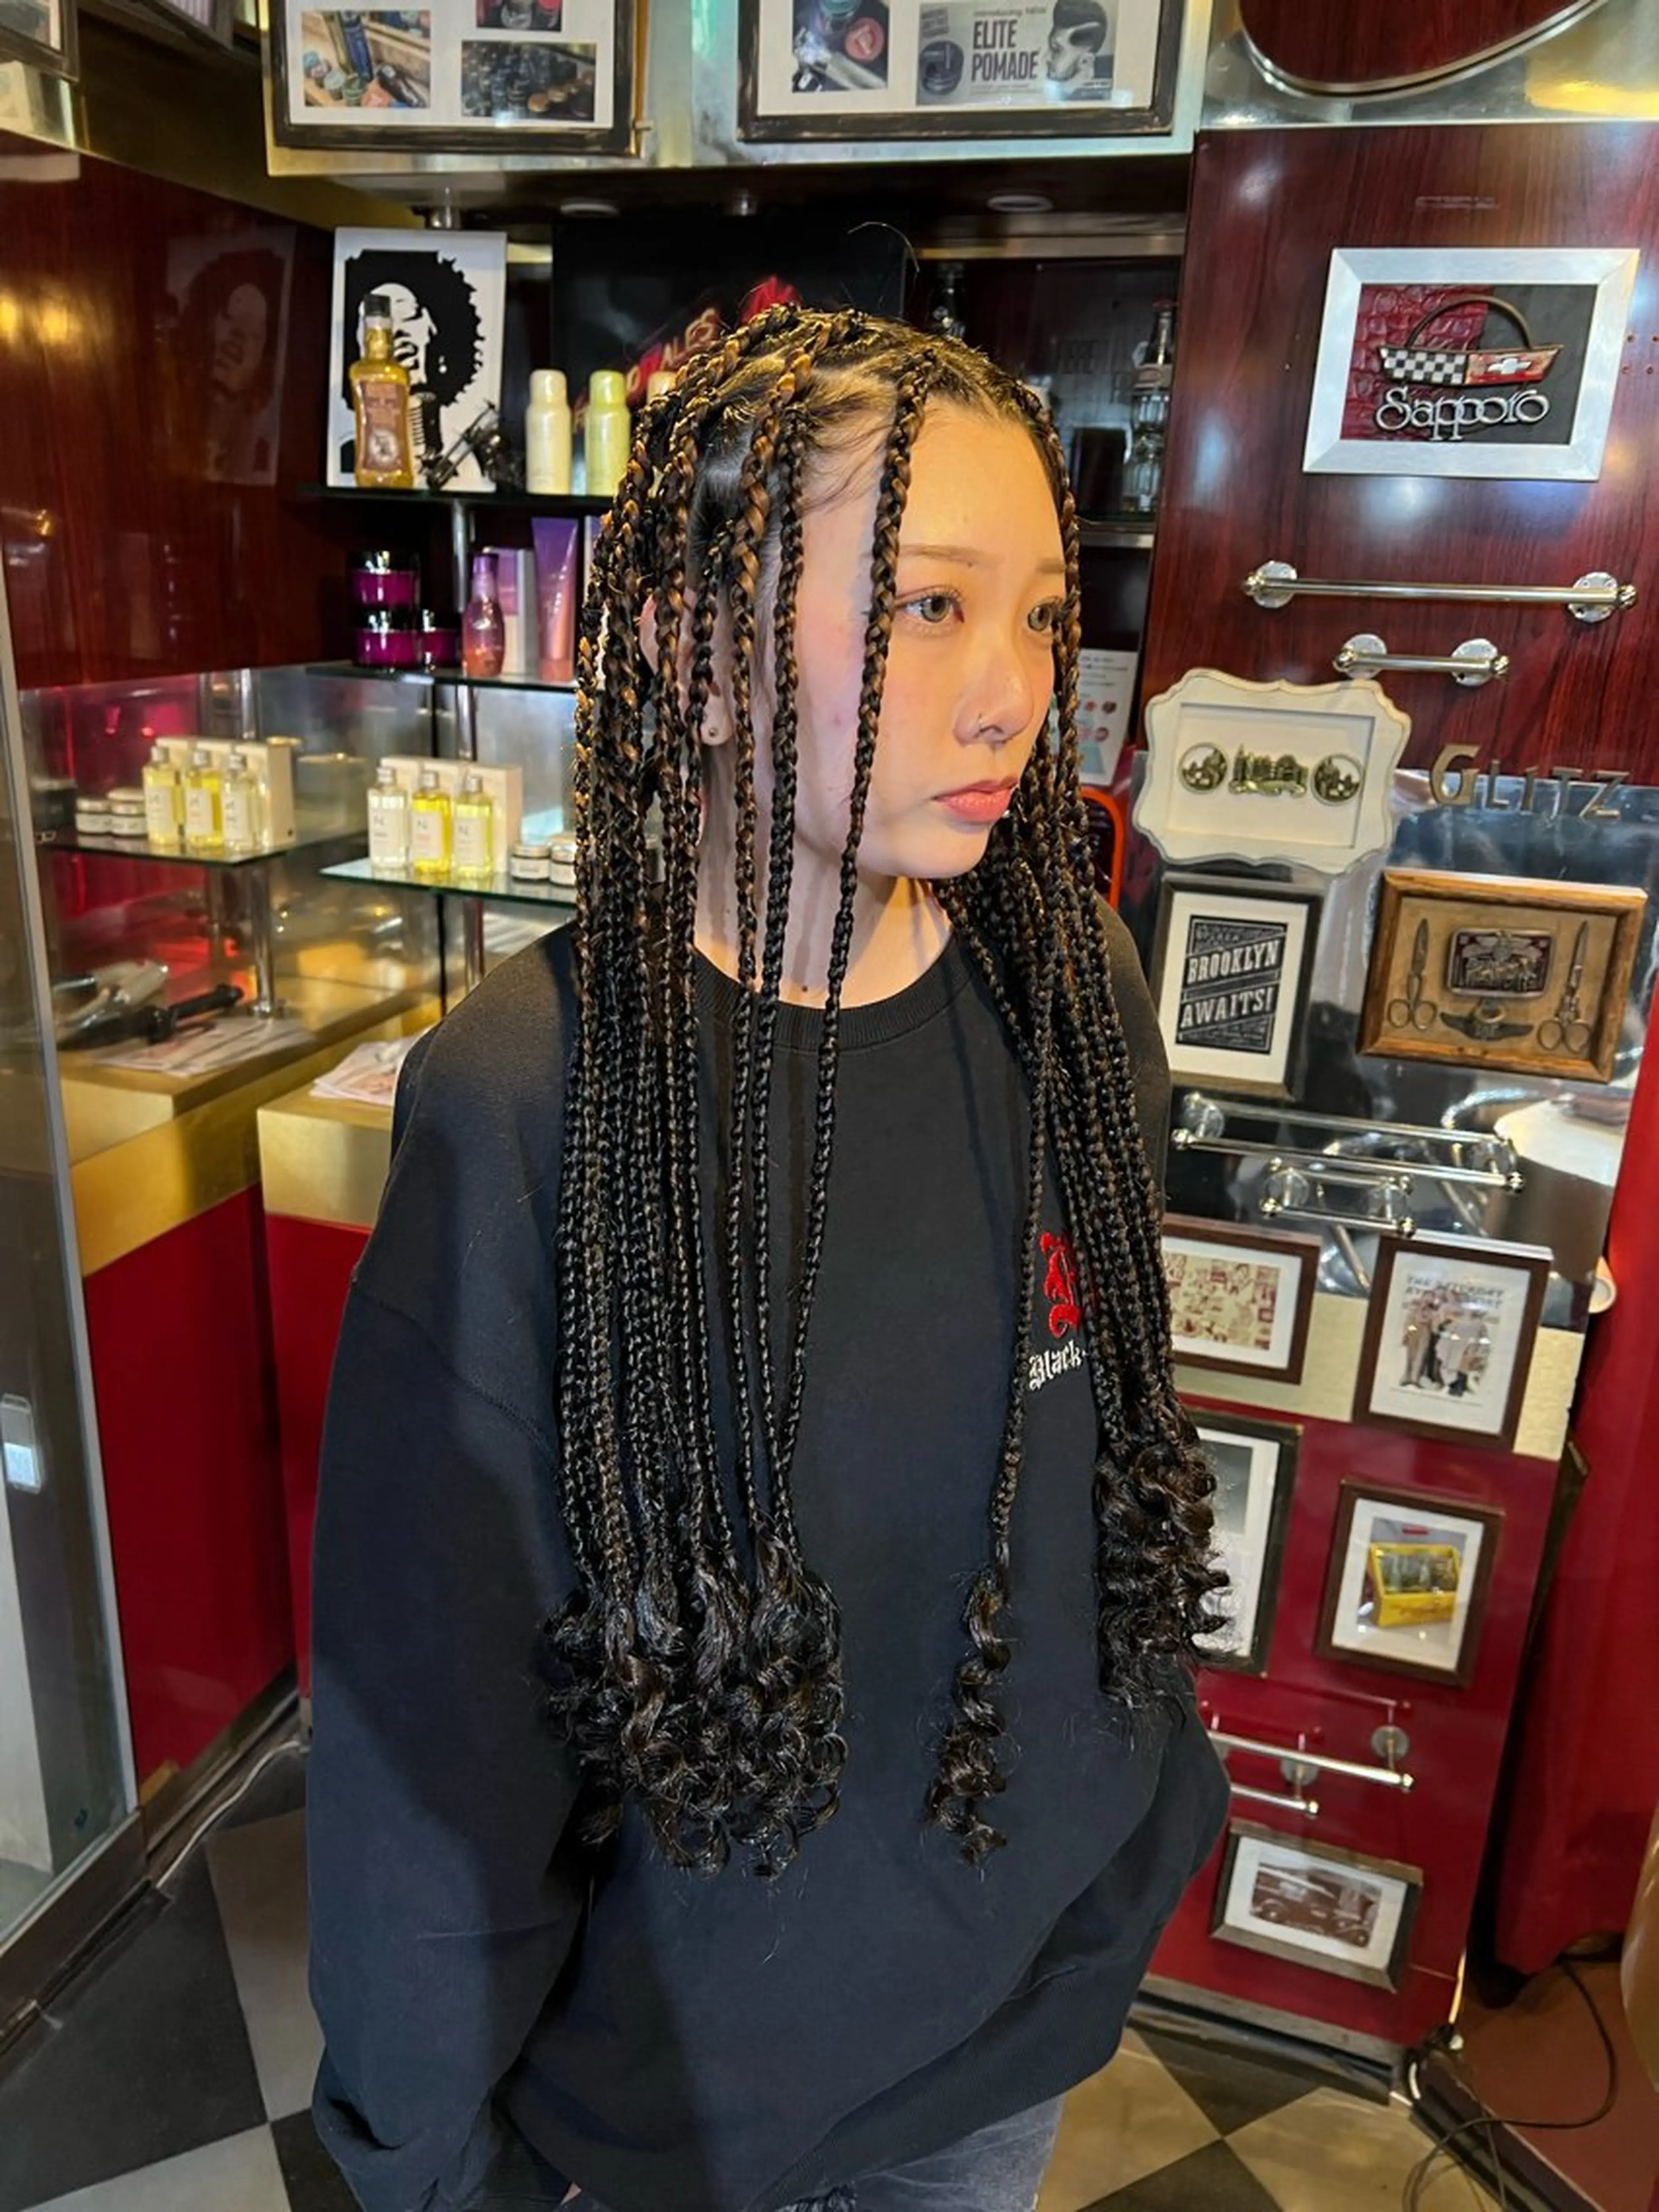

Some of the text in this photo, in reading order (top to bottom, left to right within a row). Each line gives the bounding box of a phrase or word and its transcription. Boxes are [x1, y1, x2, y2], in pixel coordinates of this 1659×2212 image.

[973, 19, 1018, 49] ELITE
[971, 51, 1038, 82] POMADE
[1376, 385, 1550, 441] Sapporo
[1431, 744, 1630, 818] GLITZ
[1187, 940, 1279, 985] BROOKLYN
[1180, 987, 1274, 1029] AWAITS!
